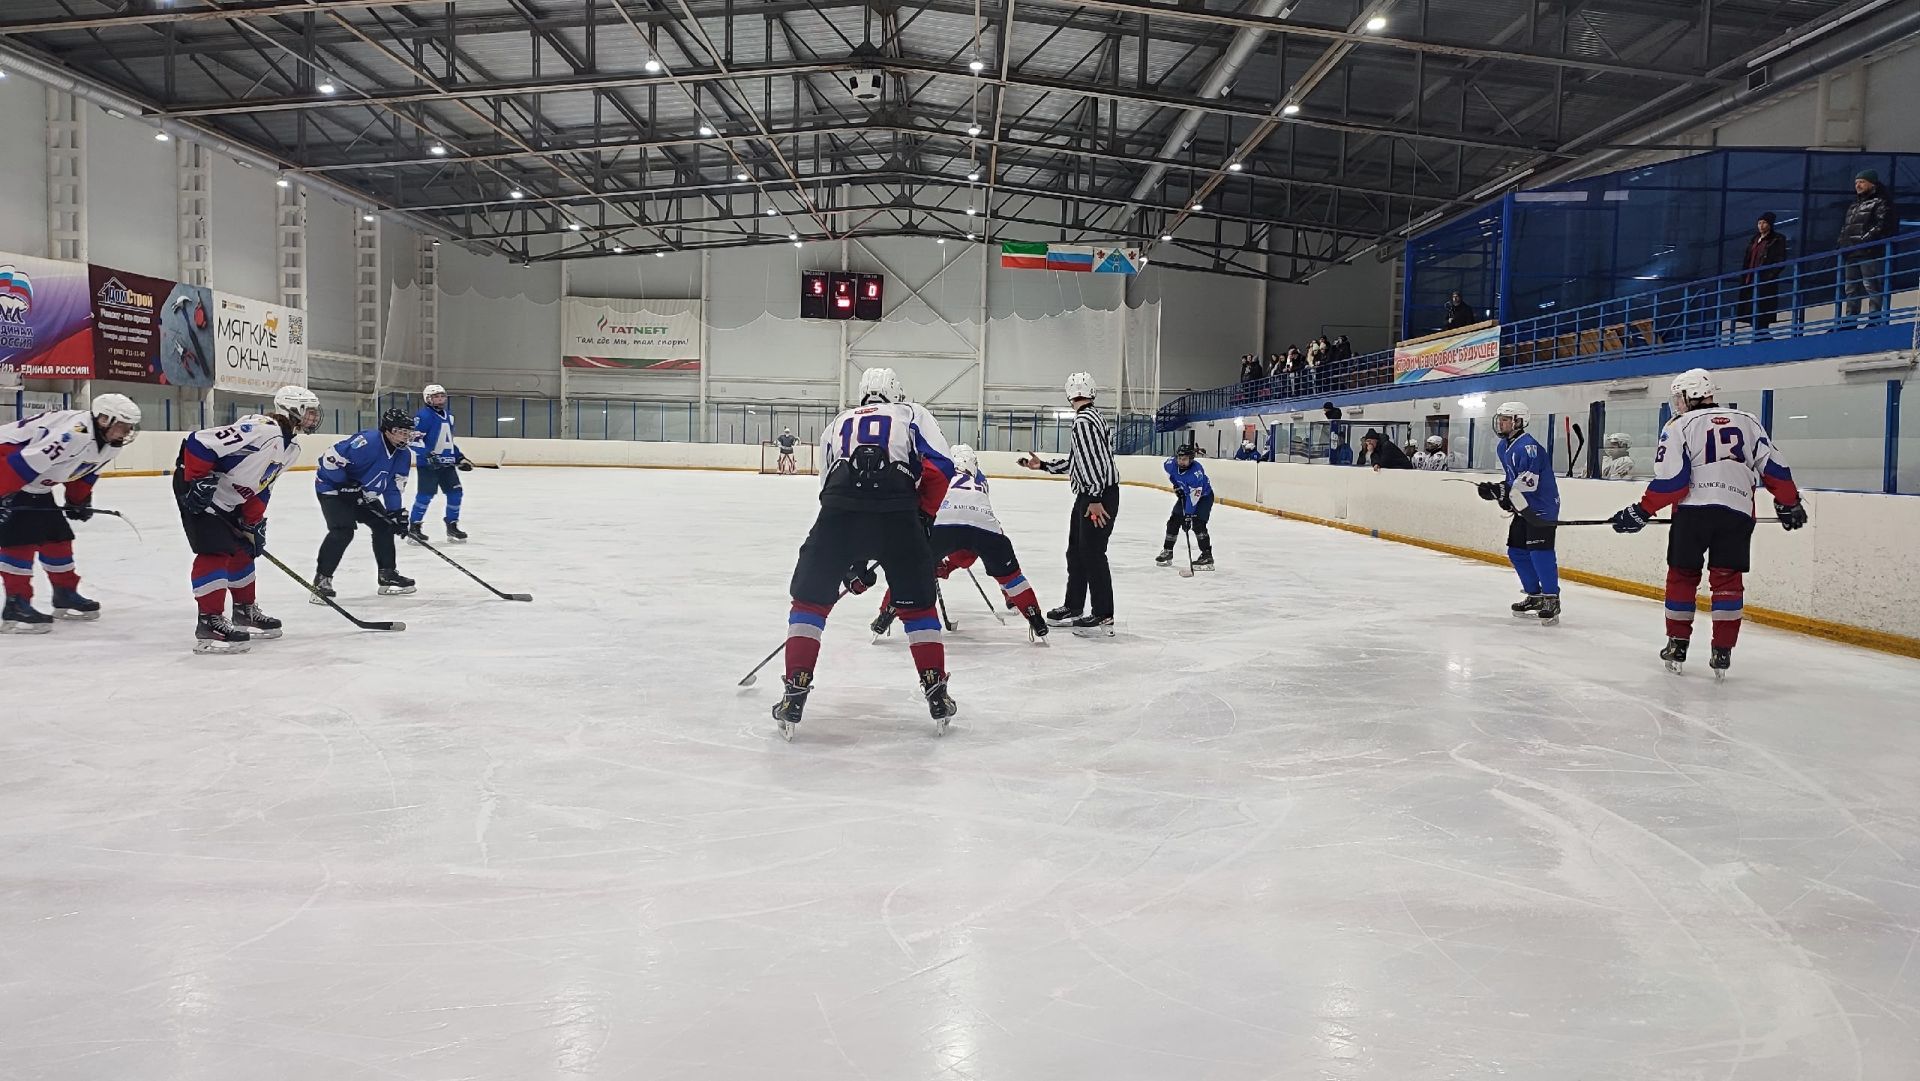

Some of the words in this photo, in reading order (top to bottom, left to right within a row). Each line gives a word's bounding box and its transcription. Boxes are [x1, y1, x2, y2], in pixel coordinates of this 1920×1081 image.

[813, 282, 823, 294] 5
[868, 285, 877, 297] 0
[0, 326, 34, 338] ДИНАЯ
[217, 315, 278, 349] МЯГКИЕ
[609, 326, 669, 335] TATNEFT
[0, 337, 33, 349] ОССИЯ
[576, 336, 594, 345] Там
[227, 345, 271, 373] ОКНА
[21, 364, 54, 375] ЕДИНАЯ
[56, 365, 90, 375] РОССИЯ!
[215, 427, 243, 446] 57
[839, 415, 892, 460] 19
